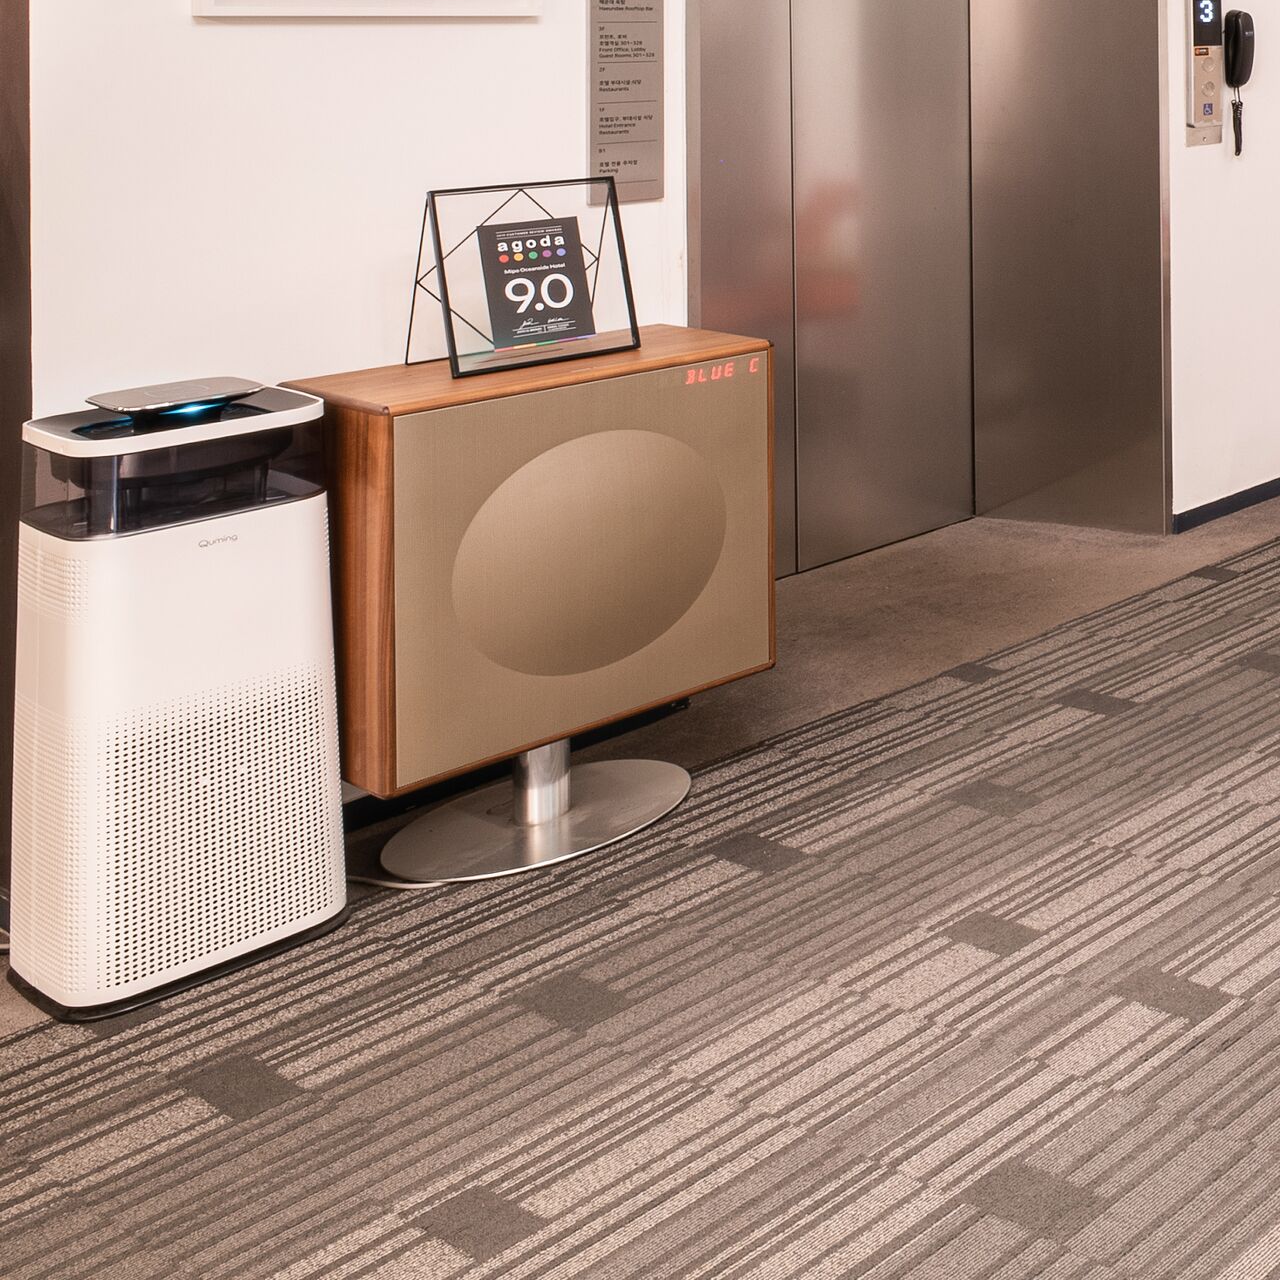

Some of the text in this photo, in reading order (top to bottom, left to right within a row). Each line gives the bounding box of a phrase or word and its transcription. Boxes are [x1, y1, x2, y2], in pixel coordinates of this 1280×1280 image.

[1200, 0, 1214, 23] 3
[497, 234, 565, 253] agoda
[504, 273, 574, 314] 9.0
[685, 362, 735, 385] BLUE
